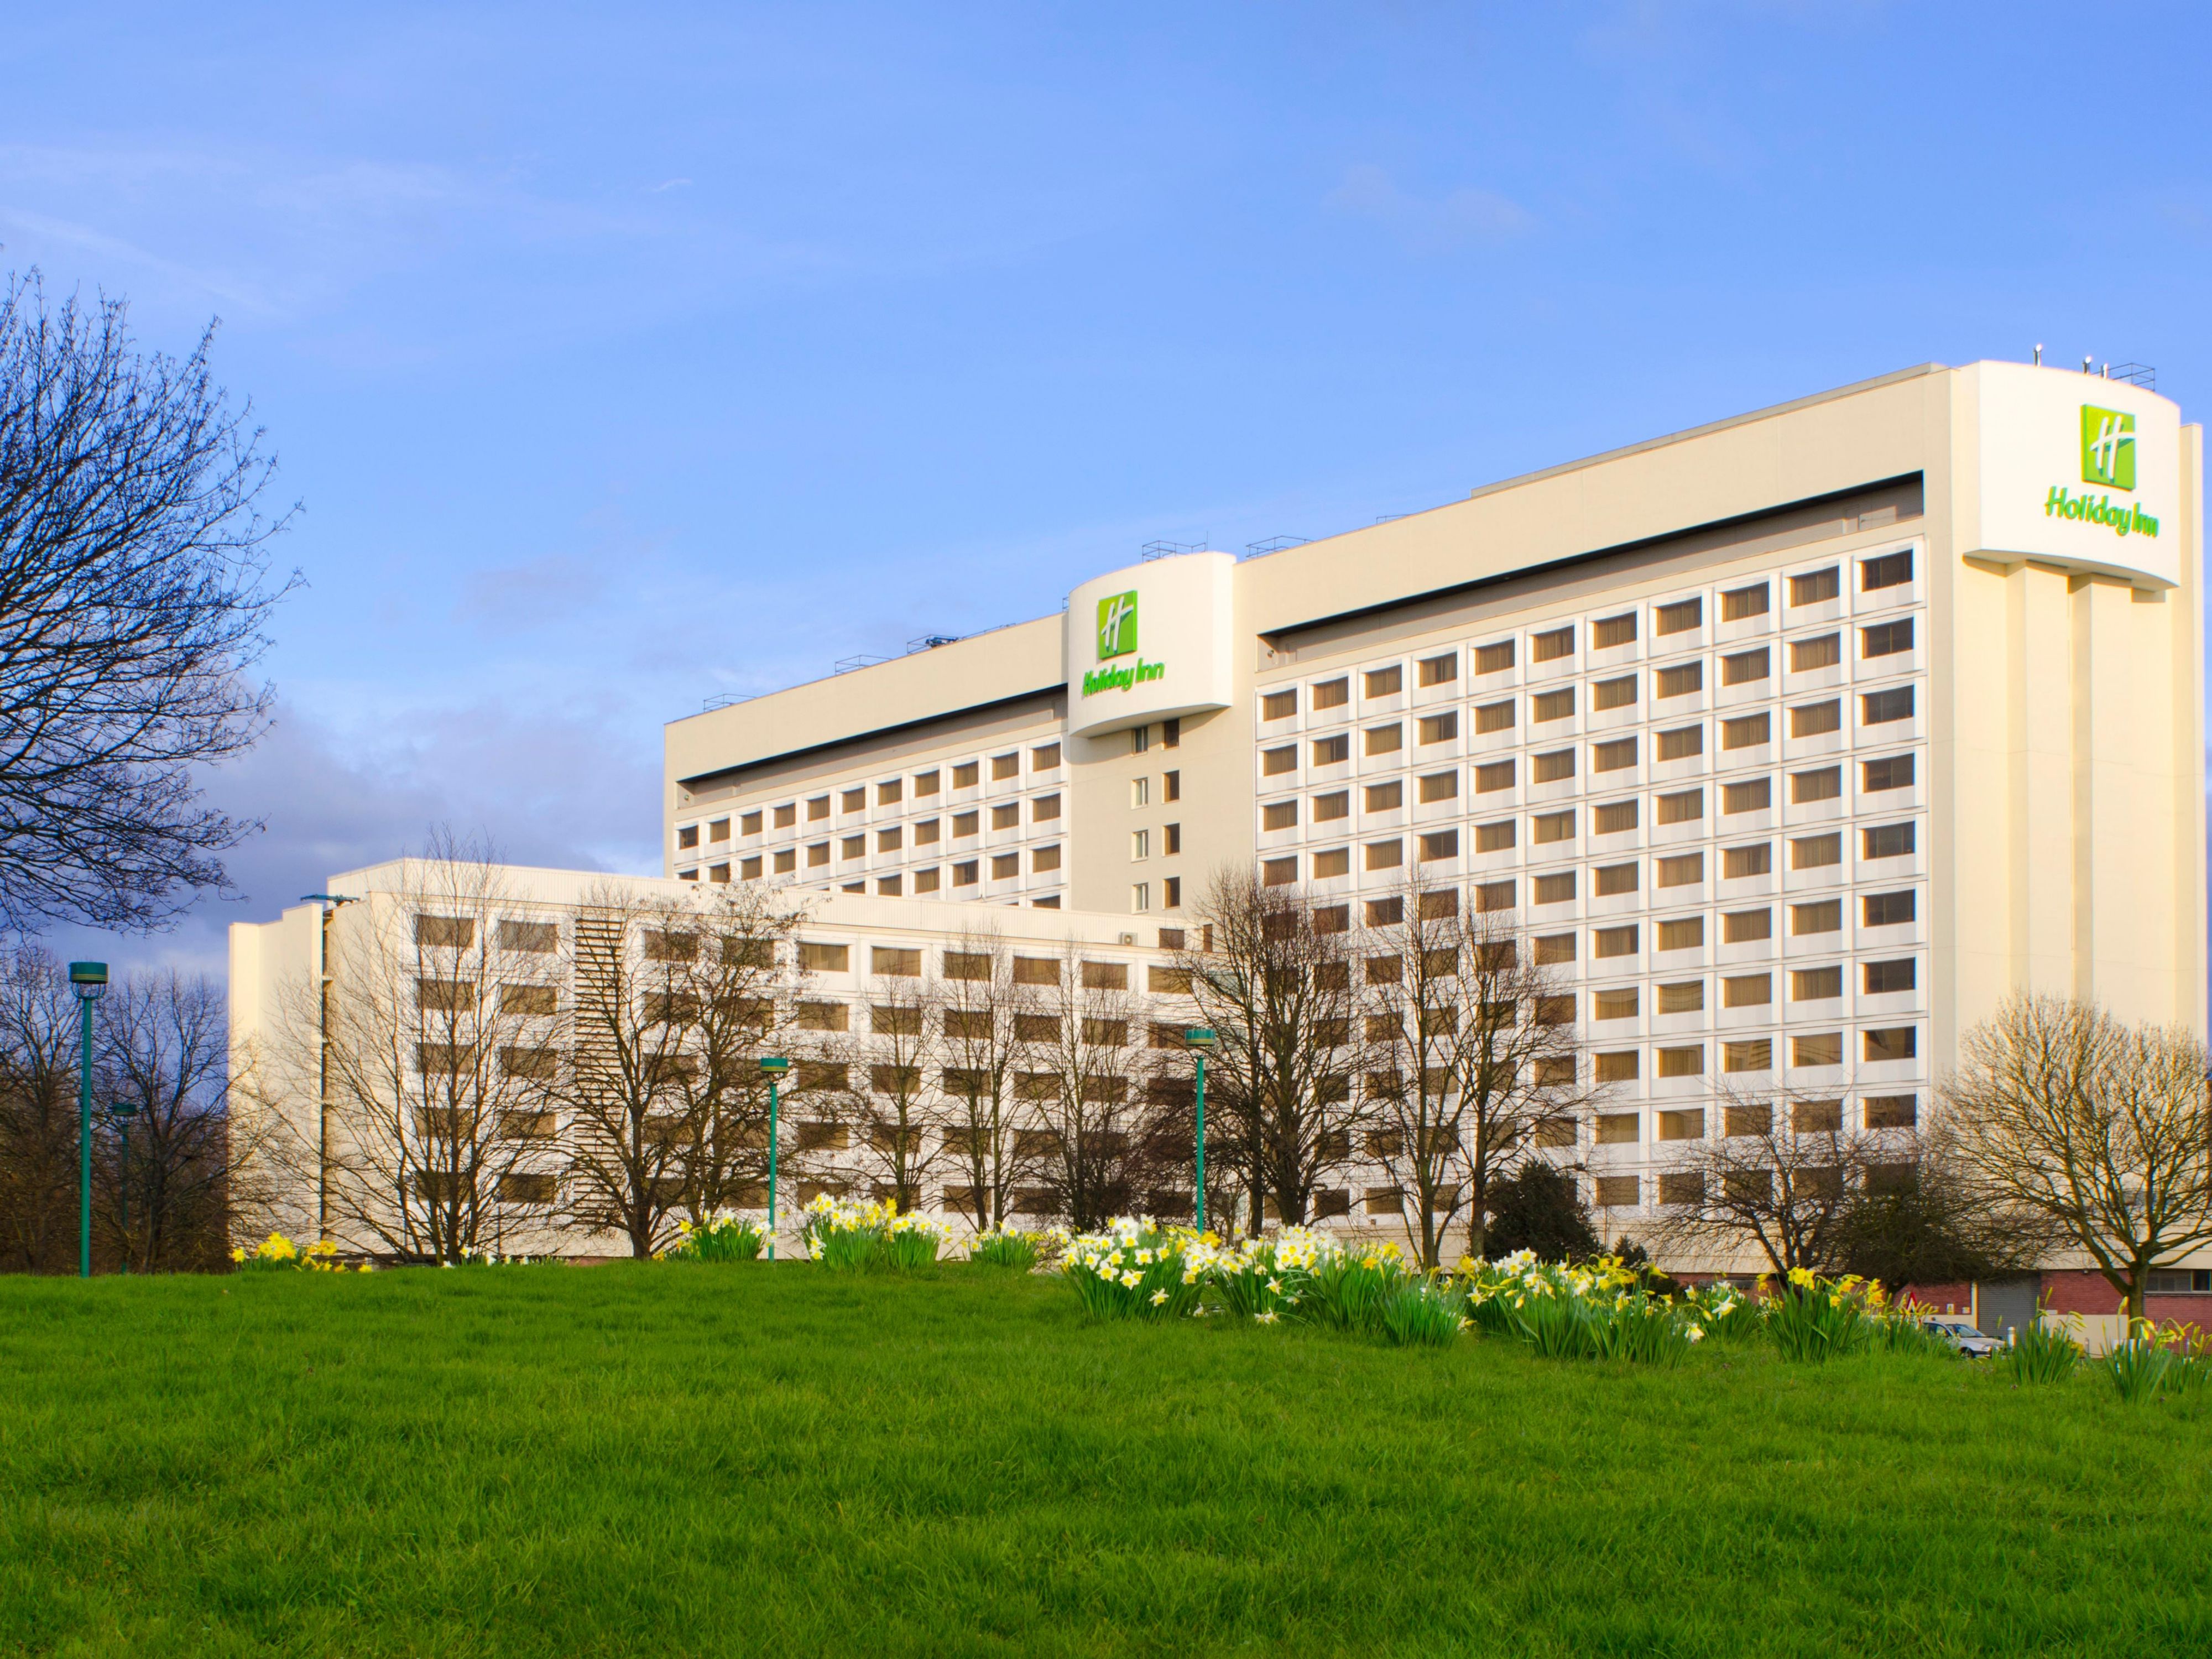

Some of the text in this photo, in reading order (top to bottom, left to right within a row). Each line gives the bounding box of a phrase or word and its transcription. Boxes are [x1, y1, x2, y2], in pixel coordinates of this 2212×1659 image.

[2044, 486, 2159, 538] Holiday Inn
[1082, 657, 1165, 696] Holiday Inn
